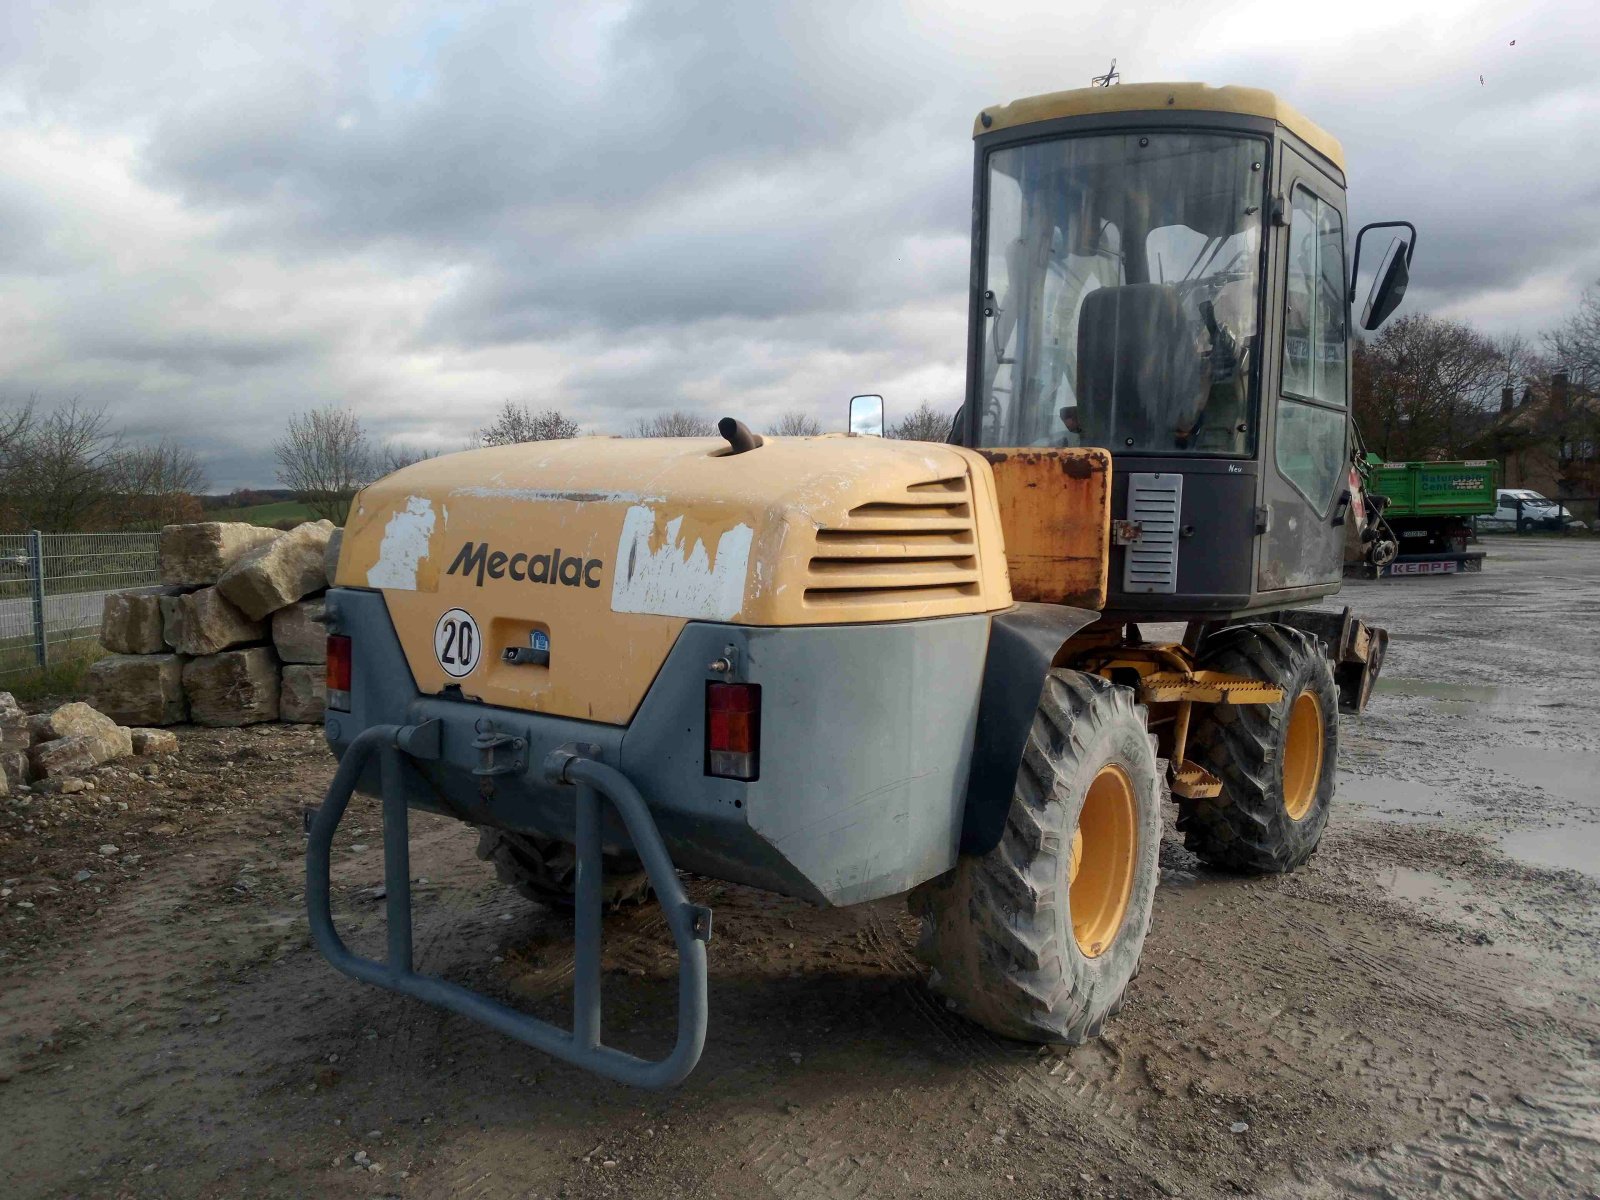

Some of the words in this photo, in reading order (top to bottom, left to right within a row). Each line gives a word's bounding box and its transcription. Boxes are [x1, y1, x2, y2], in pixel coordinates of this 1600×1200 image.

[446, 541, 603, 588] Mecalac
[1393, 562, 1456, 574] KEMPF
[441, 618, 473, 666] 20
